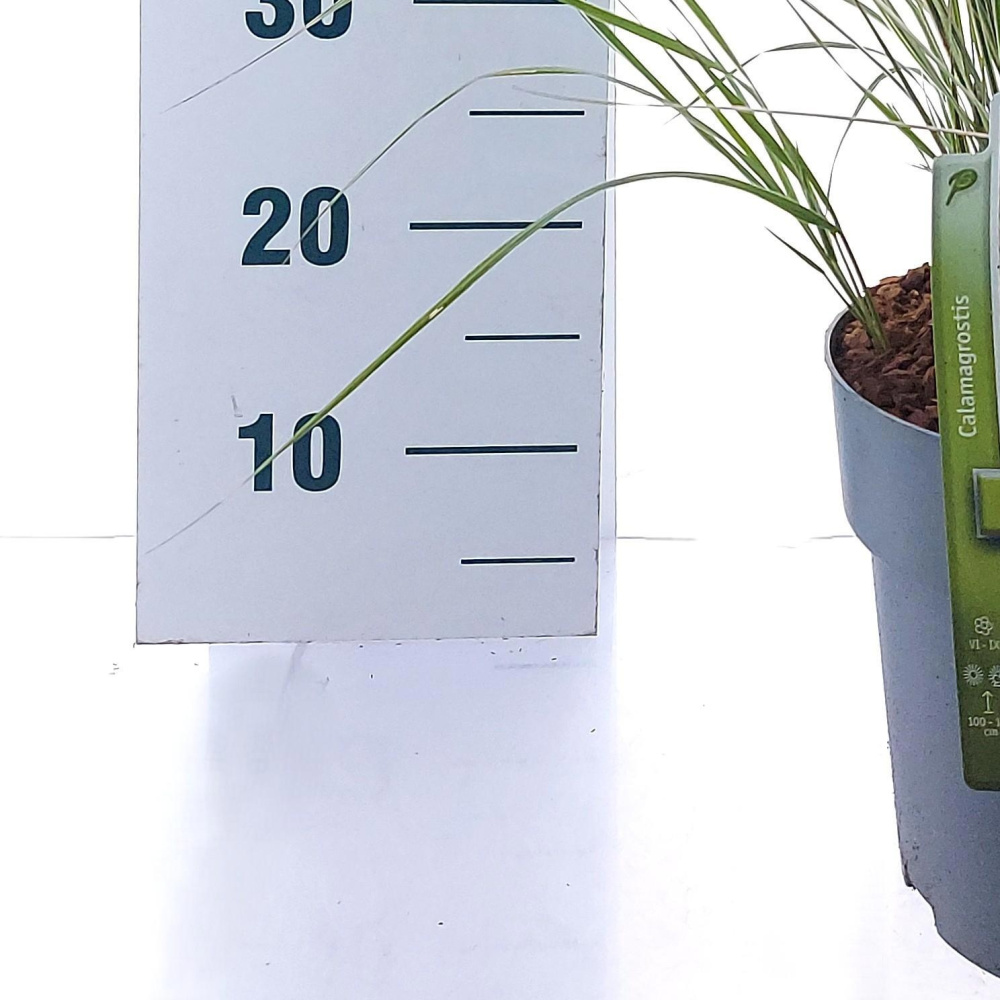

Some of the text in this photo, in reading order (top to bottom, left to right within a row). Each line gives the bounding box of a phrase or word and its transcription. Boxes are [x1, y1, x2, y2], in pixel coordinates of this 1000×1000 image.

[242, 187, 349, 266] 20
[953, 295, 977, 438] Calamagrostis
[239, 414, 341, 491] 10
[968, 717, 986, 727] 100
